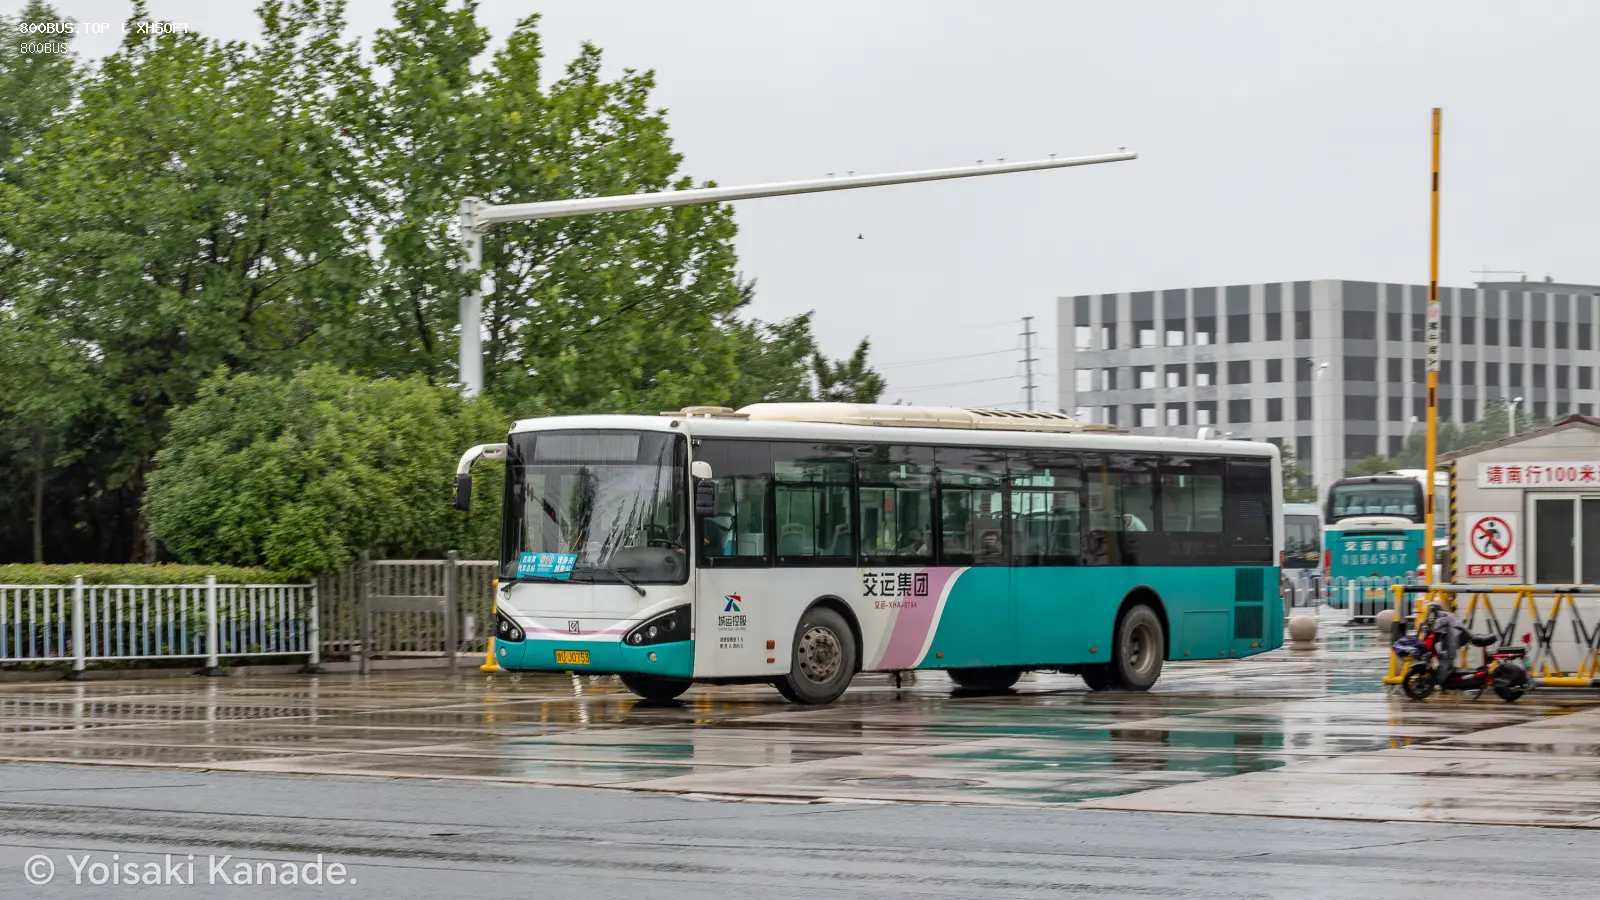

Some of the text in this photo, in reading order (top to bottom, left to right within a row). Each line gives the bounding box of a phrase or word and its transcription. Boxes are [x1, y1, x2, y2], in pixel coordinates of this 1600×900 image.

[1487, 464, 1600, 484] 请南行100米
[863, 572, 929, 597] 交运集团
